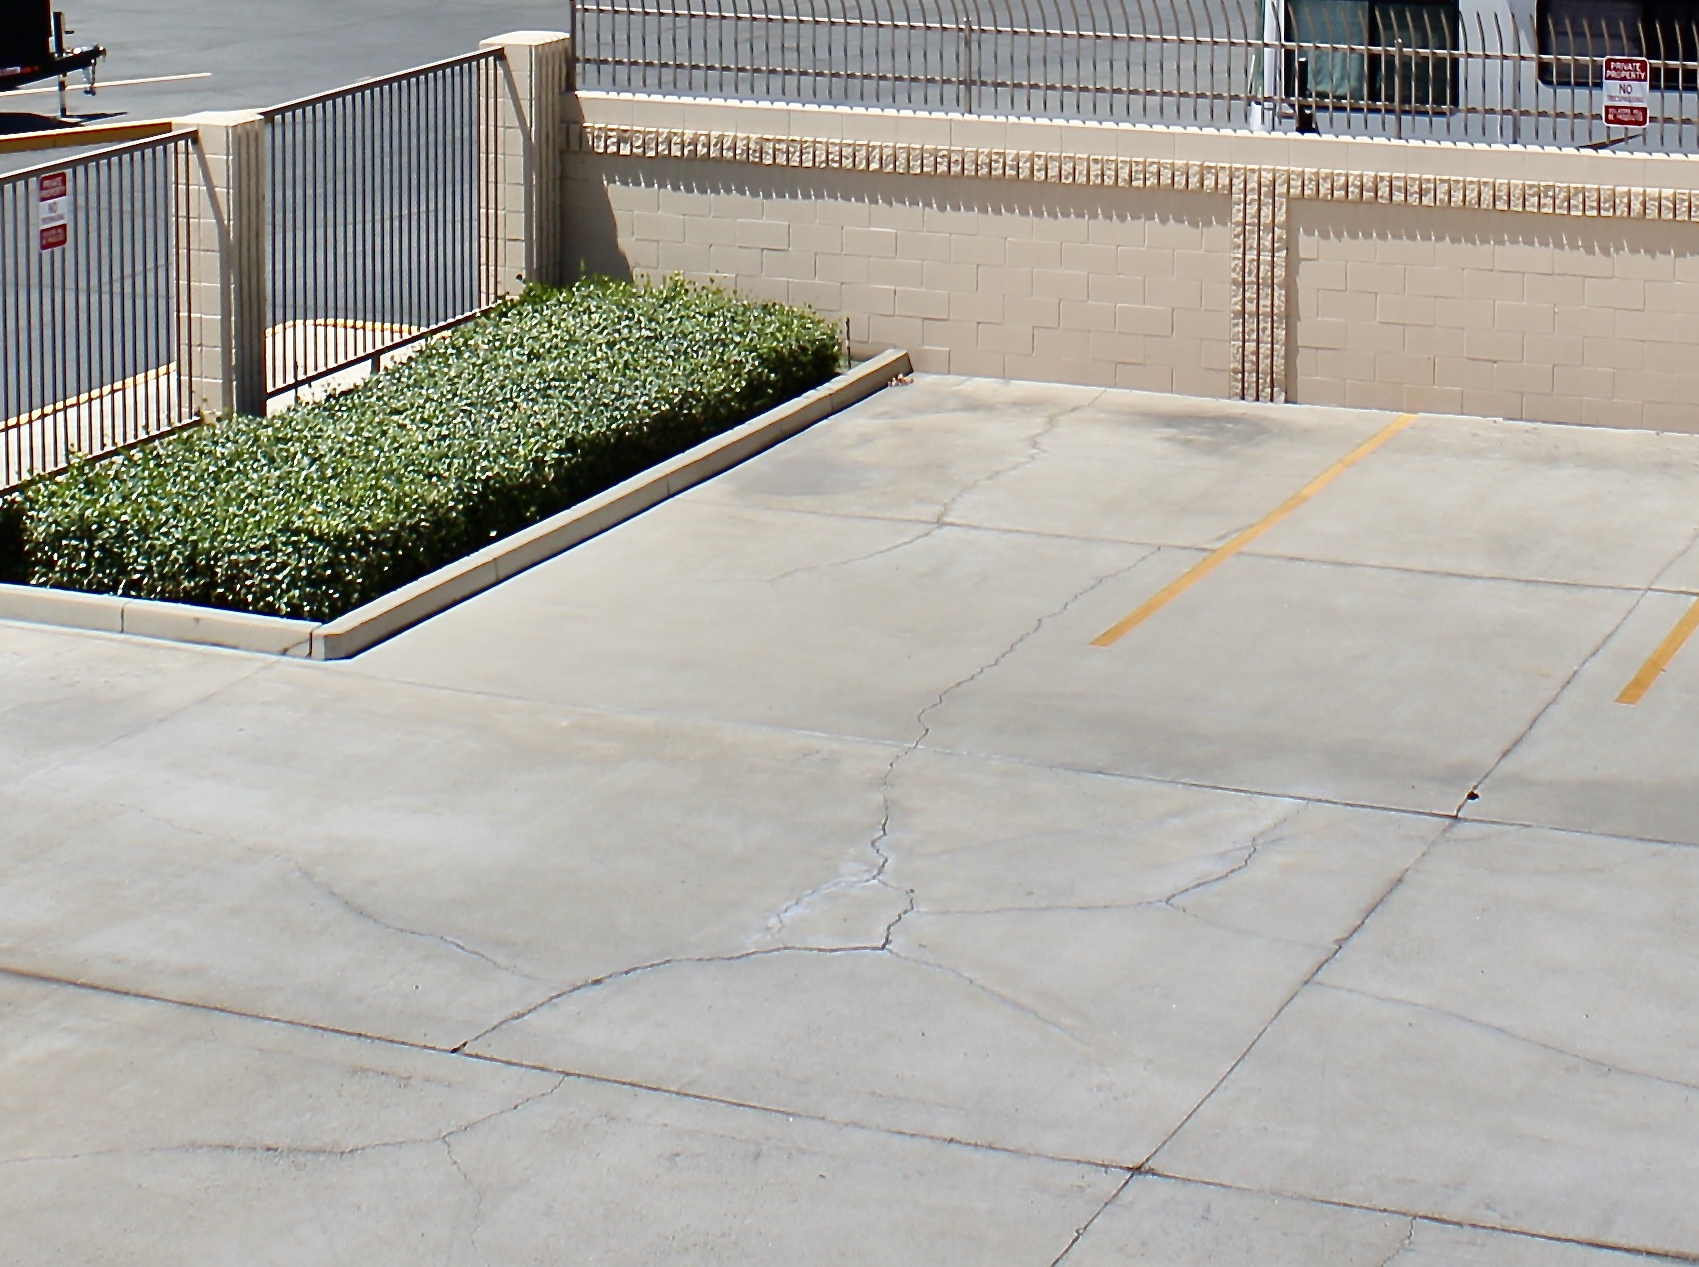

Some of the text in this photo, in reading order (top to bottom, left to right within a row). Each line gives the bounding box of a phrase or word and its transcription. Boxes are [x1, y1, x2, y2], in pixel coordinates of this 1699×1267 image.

[1610, 61, 1642, 71] PRIVATE
[1605, 69, 1646, 80] PROPERTY
[1619, 83, 1633, 95] NO
